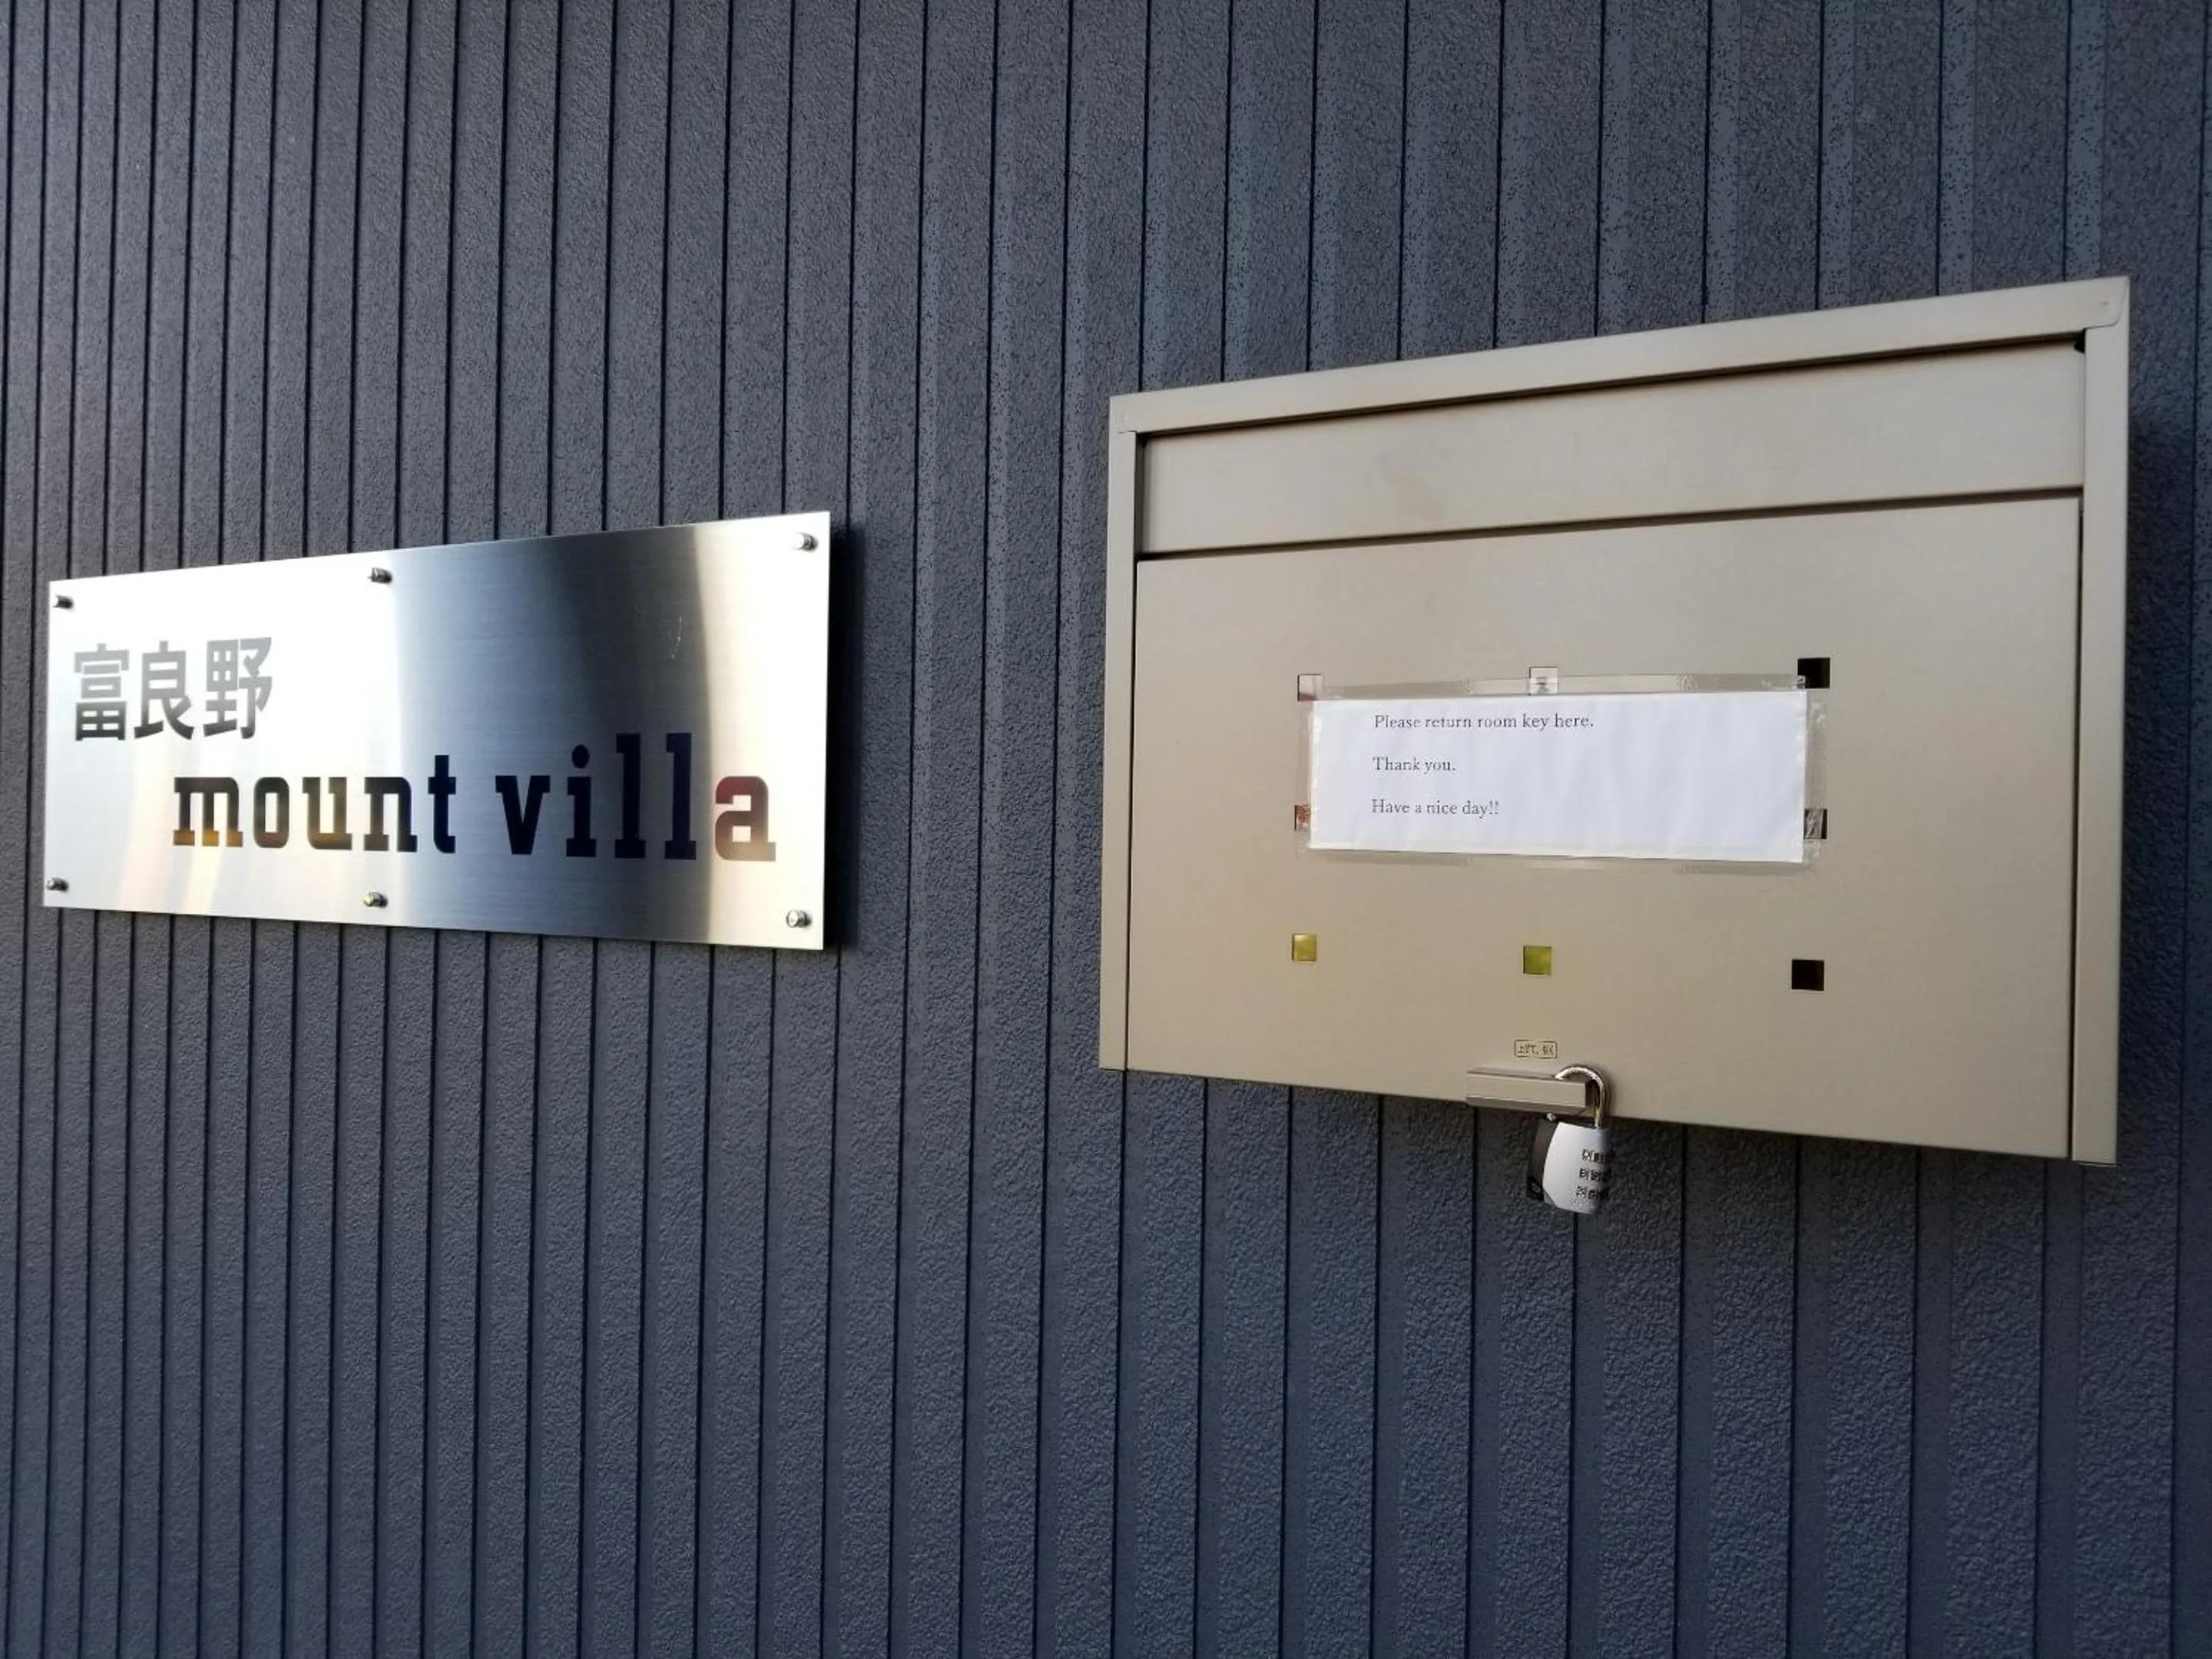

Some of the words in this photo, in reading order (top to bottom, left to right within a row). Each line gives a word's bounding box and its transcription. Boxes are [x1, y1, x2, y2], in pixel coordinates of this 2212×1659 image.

[73, 637, 273, 741] 富良野
[1375, 714, 1421, 728] Please
[1425, 717, 1472, 727] return
[1477, 717, 1518, 727] room
[1522, 714, 1549, 730] key
[1555, 714, 1594, 728] here.
[1373, 757, 1419, 771] Thank
[1425, 760, 1456, 774] you.
[173, 753, 457, 854] mount
[495, 732, 777, 862] villa
[1372, 799, 1411, 813] Have
[1414, 805, 1422, 813] a
[1426, 801, 1458, 815] nice
[1462, 801, 1499, 819] day!!
